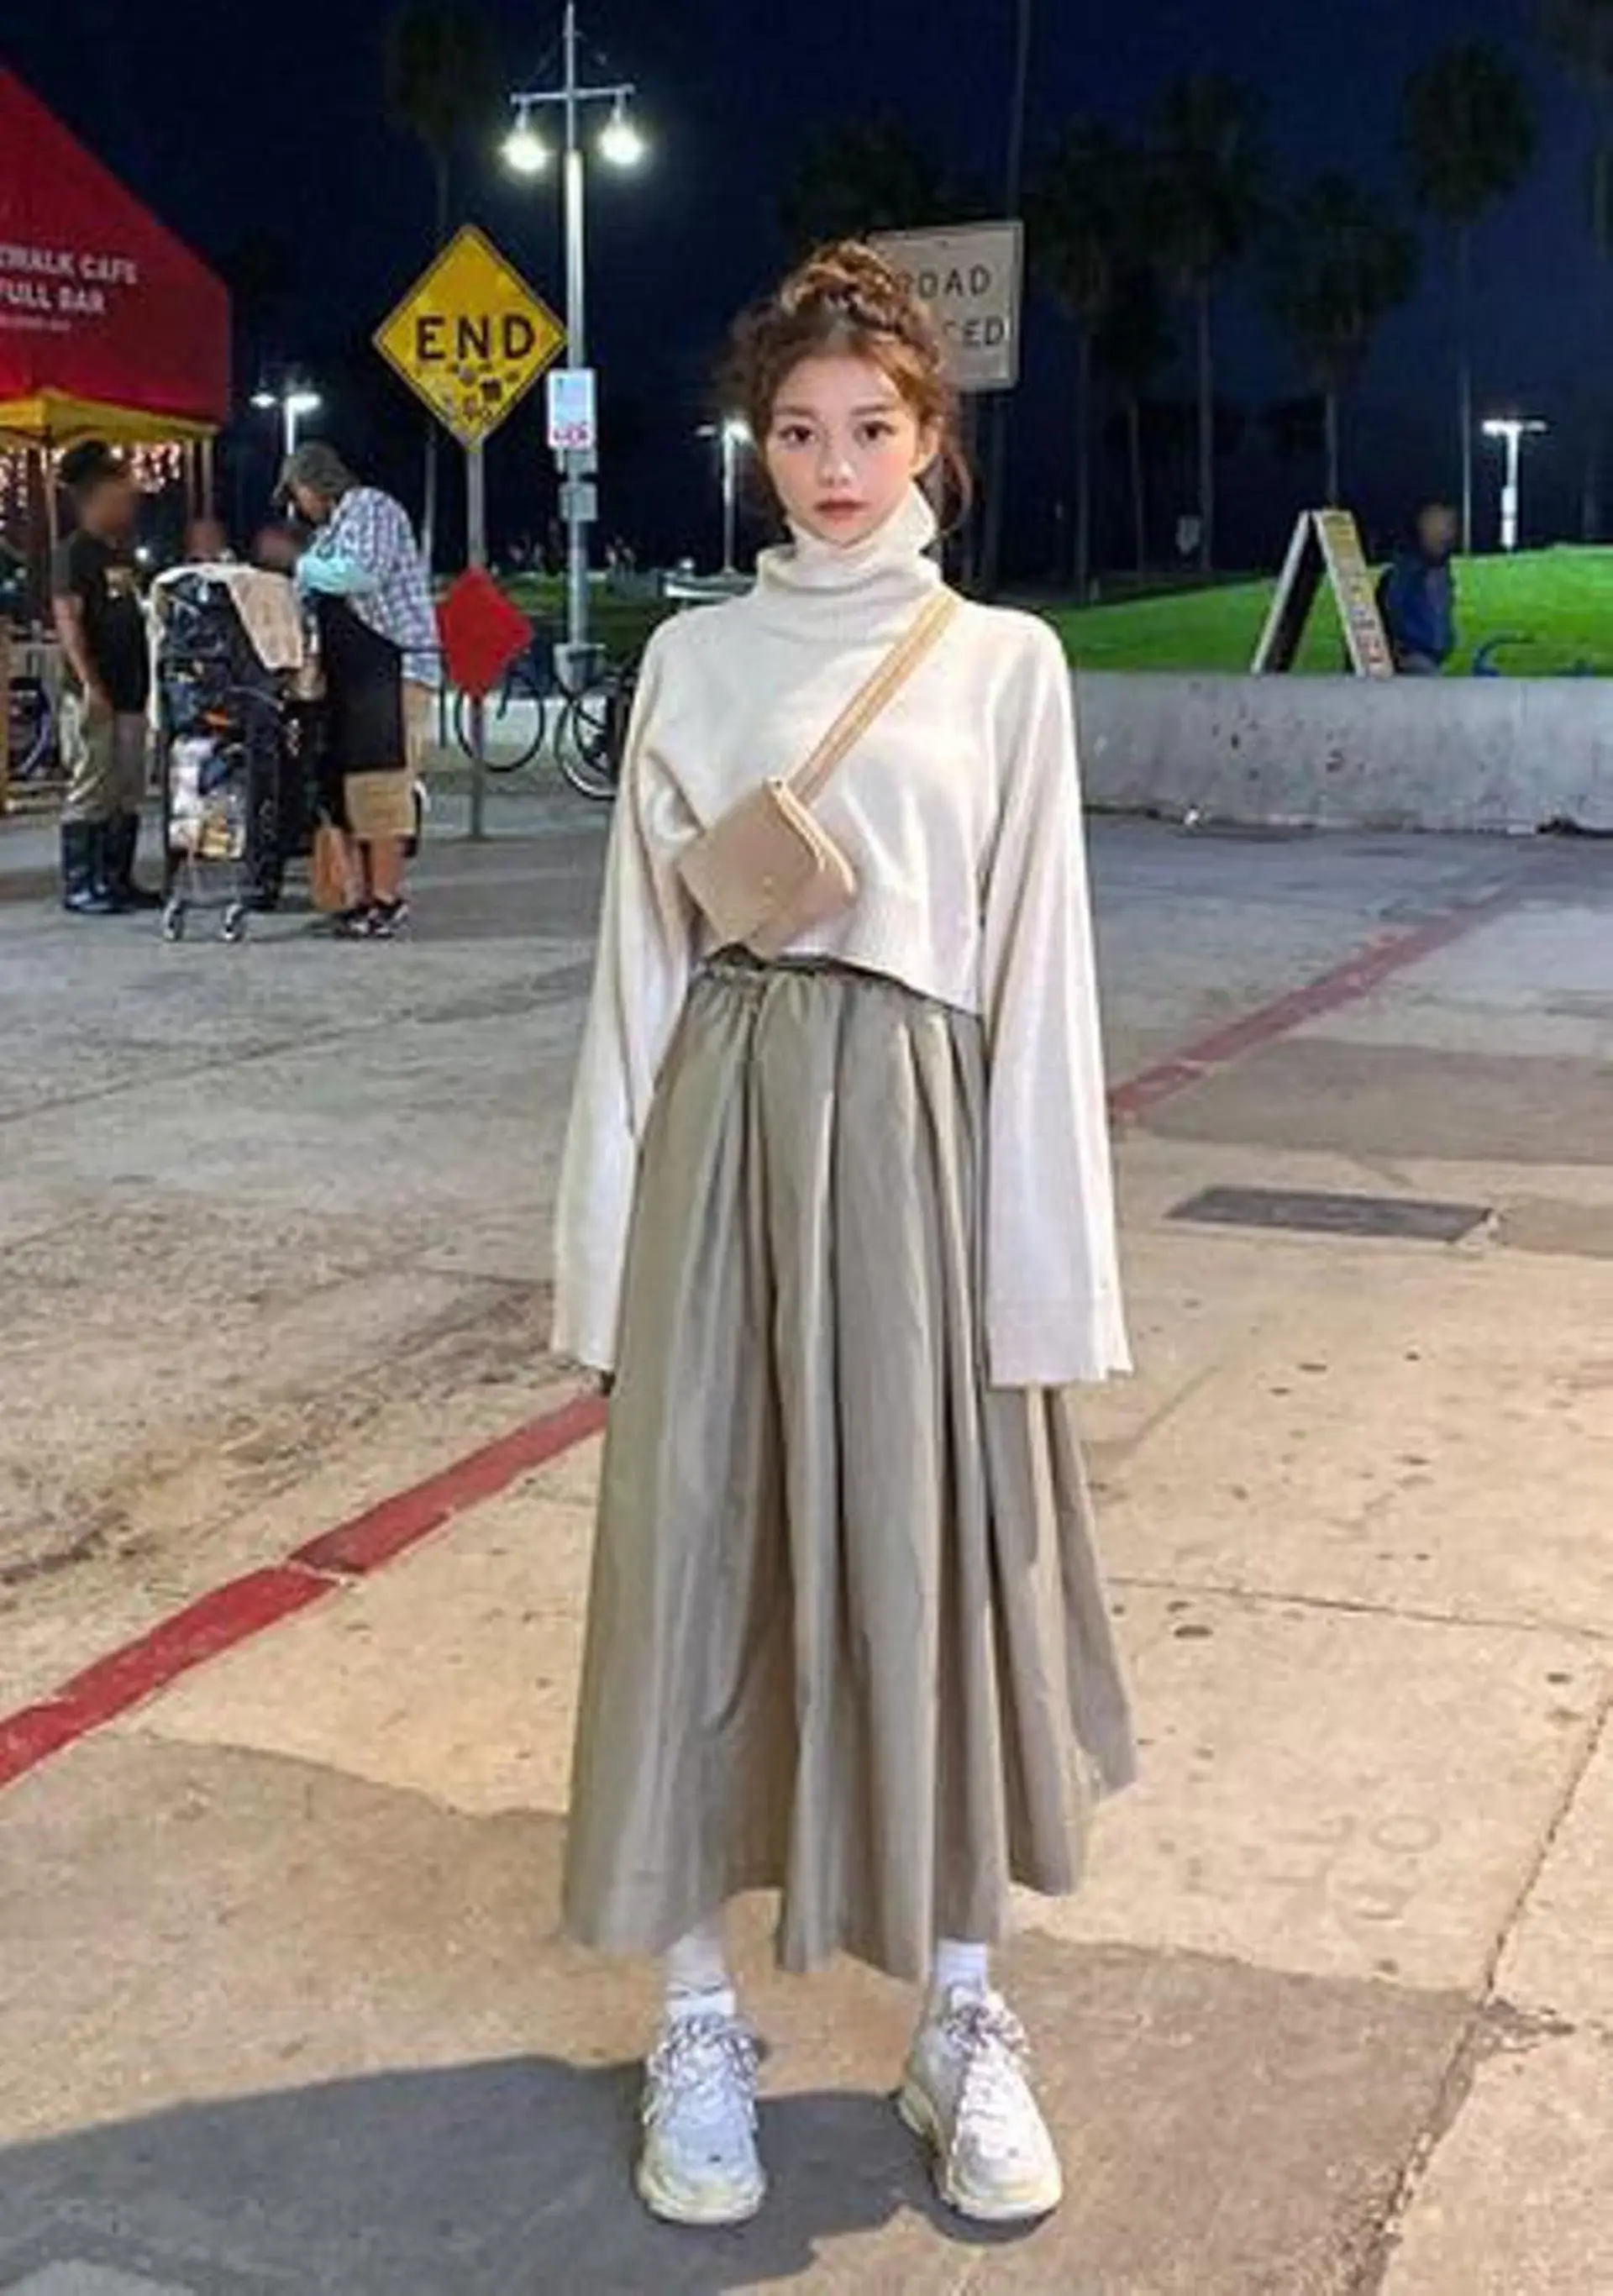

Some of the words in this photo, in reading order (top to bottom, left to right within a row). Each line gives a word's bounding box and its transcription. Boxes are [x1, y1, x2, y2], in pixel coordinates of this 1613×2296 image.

[80, 255, 137, 285] CAFE
[58, 286, 105, 313] BAR
[415, 313, 536, 360] END
